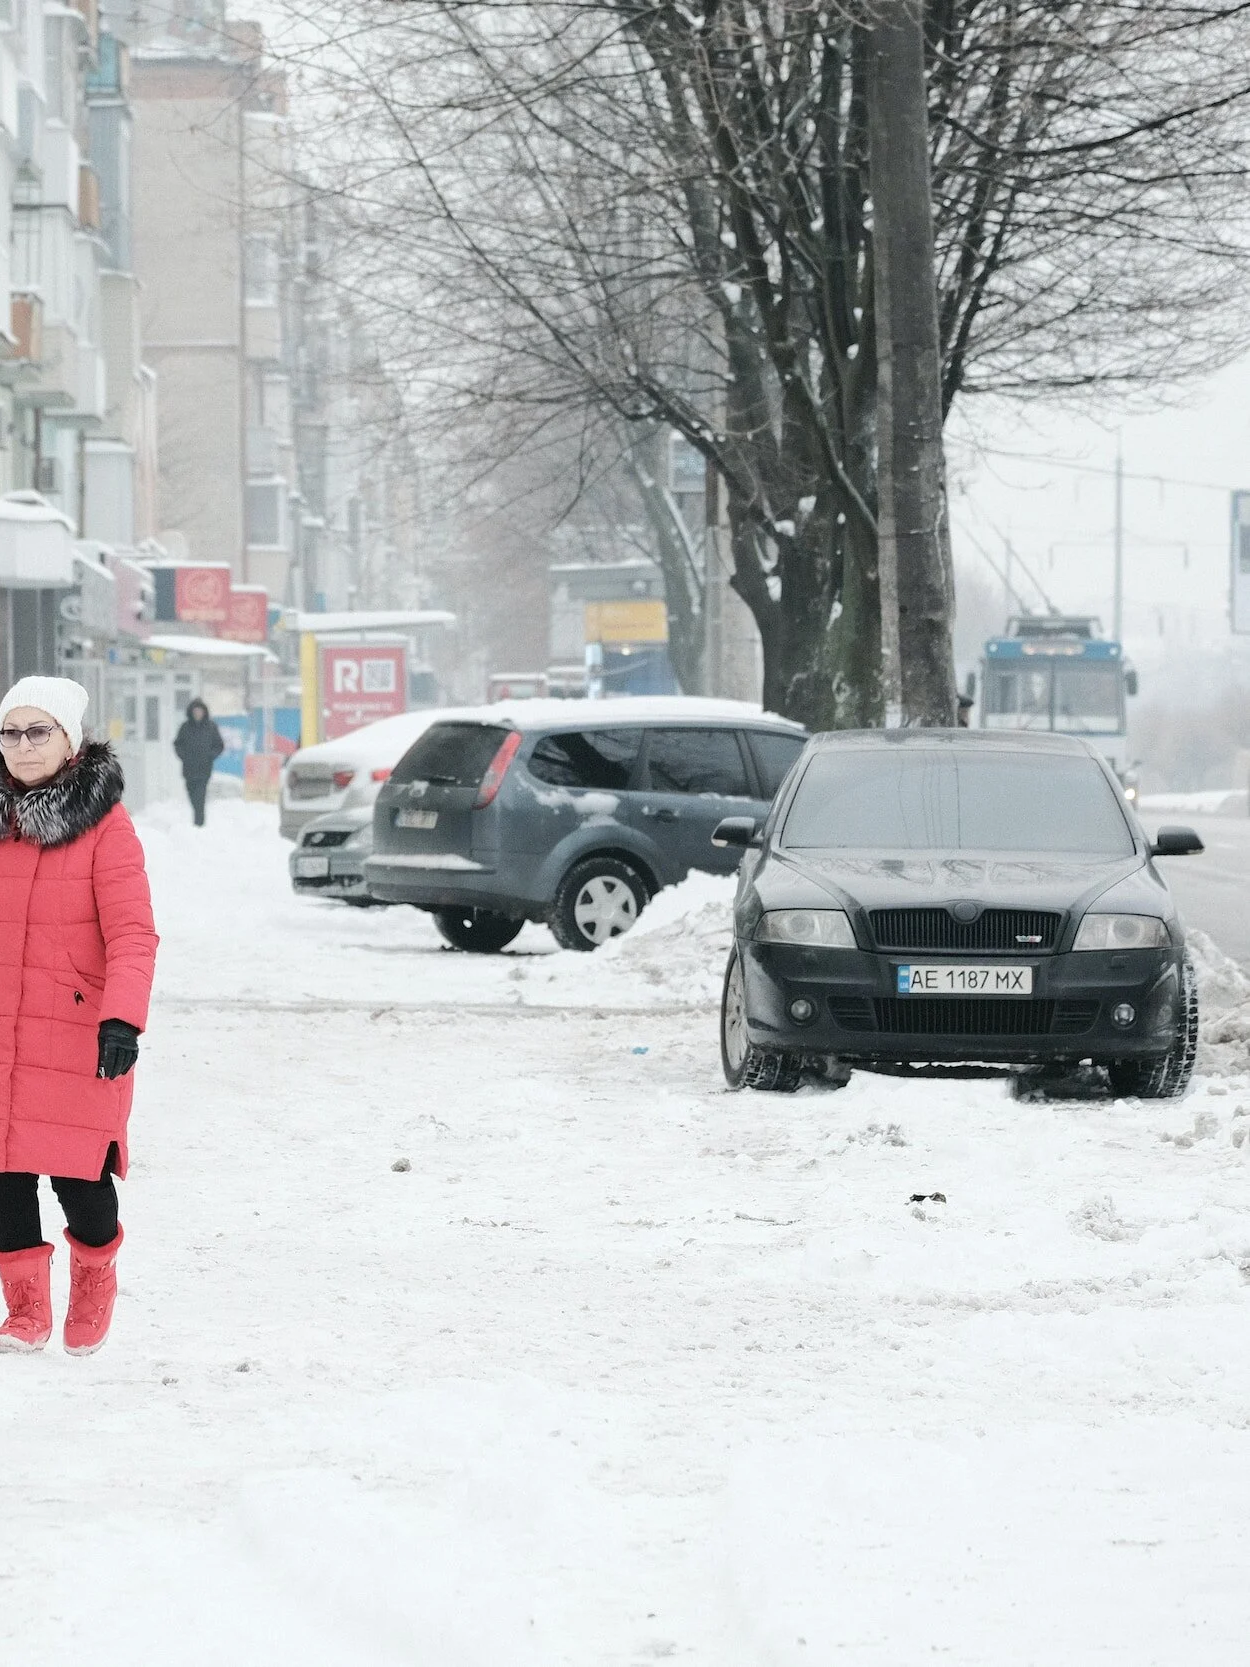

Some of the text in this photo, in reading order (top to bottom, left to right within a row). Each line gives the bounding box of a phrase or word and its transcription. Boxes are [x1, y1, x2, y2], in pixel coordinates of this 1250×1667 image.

[911, 970, 1024, 990] AE 1187 MX
